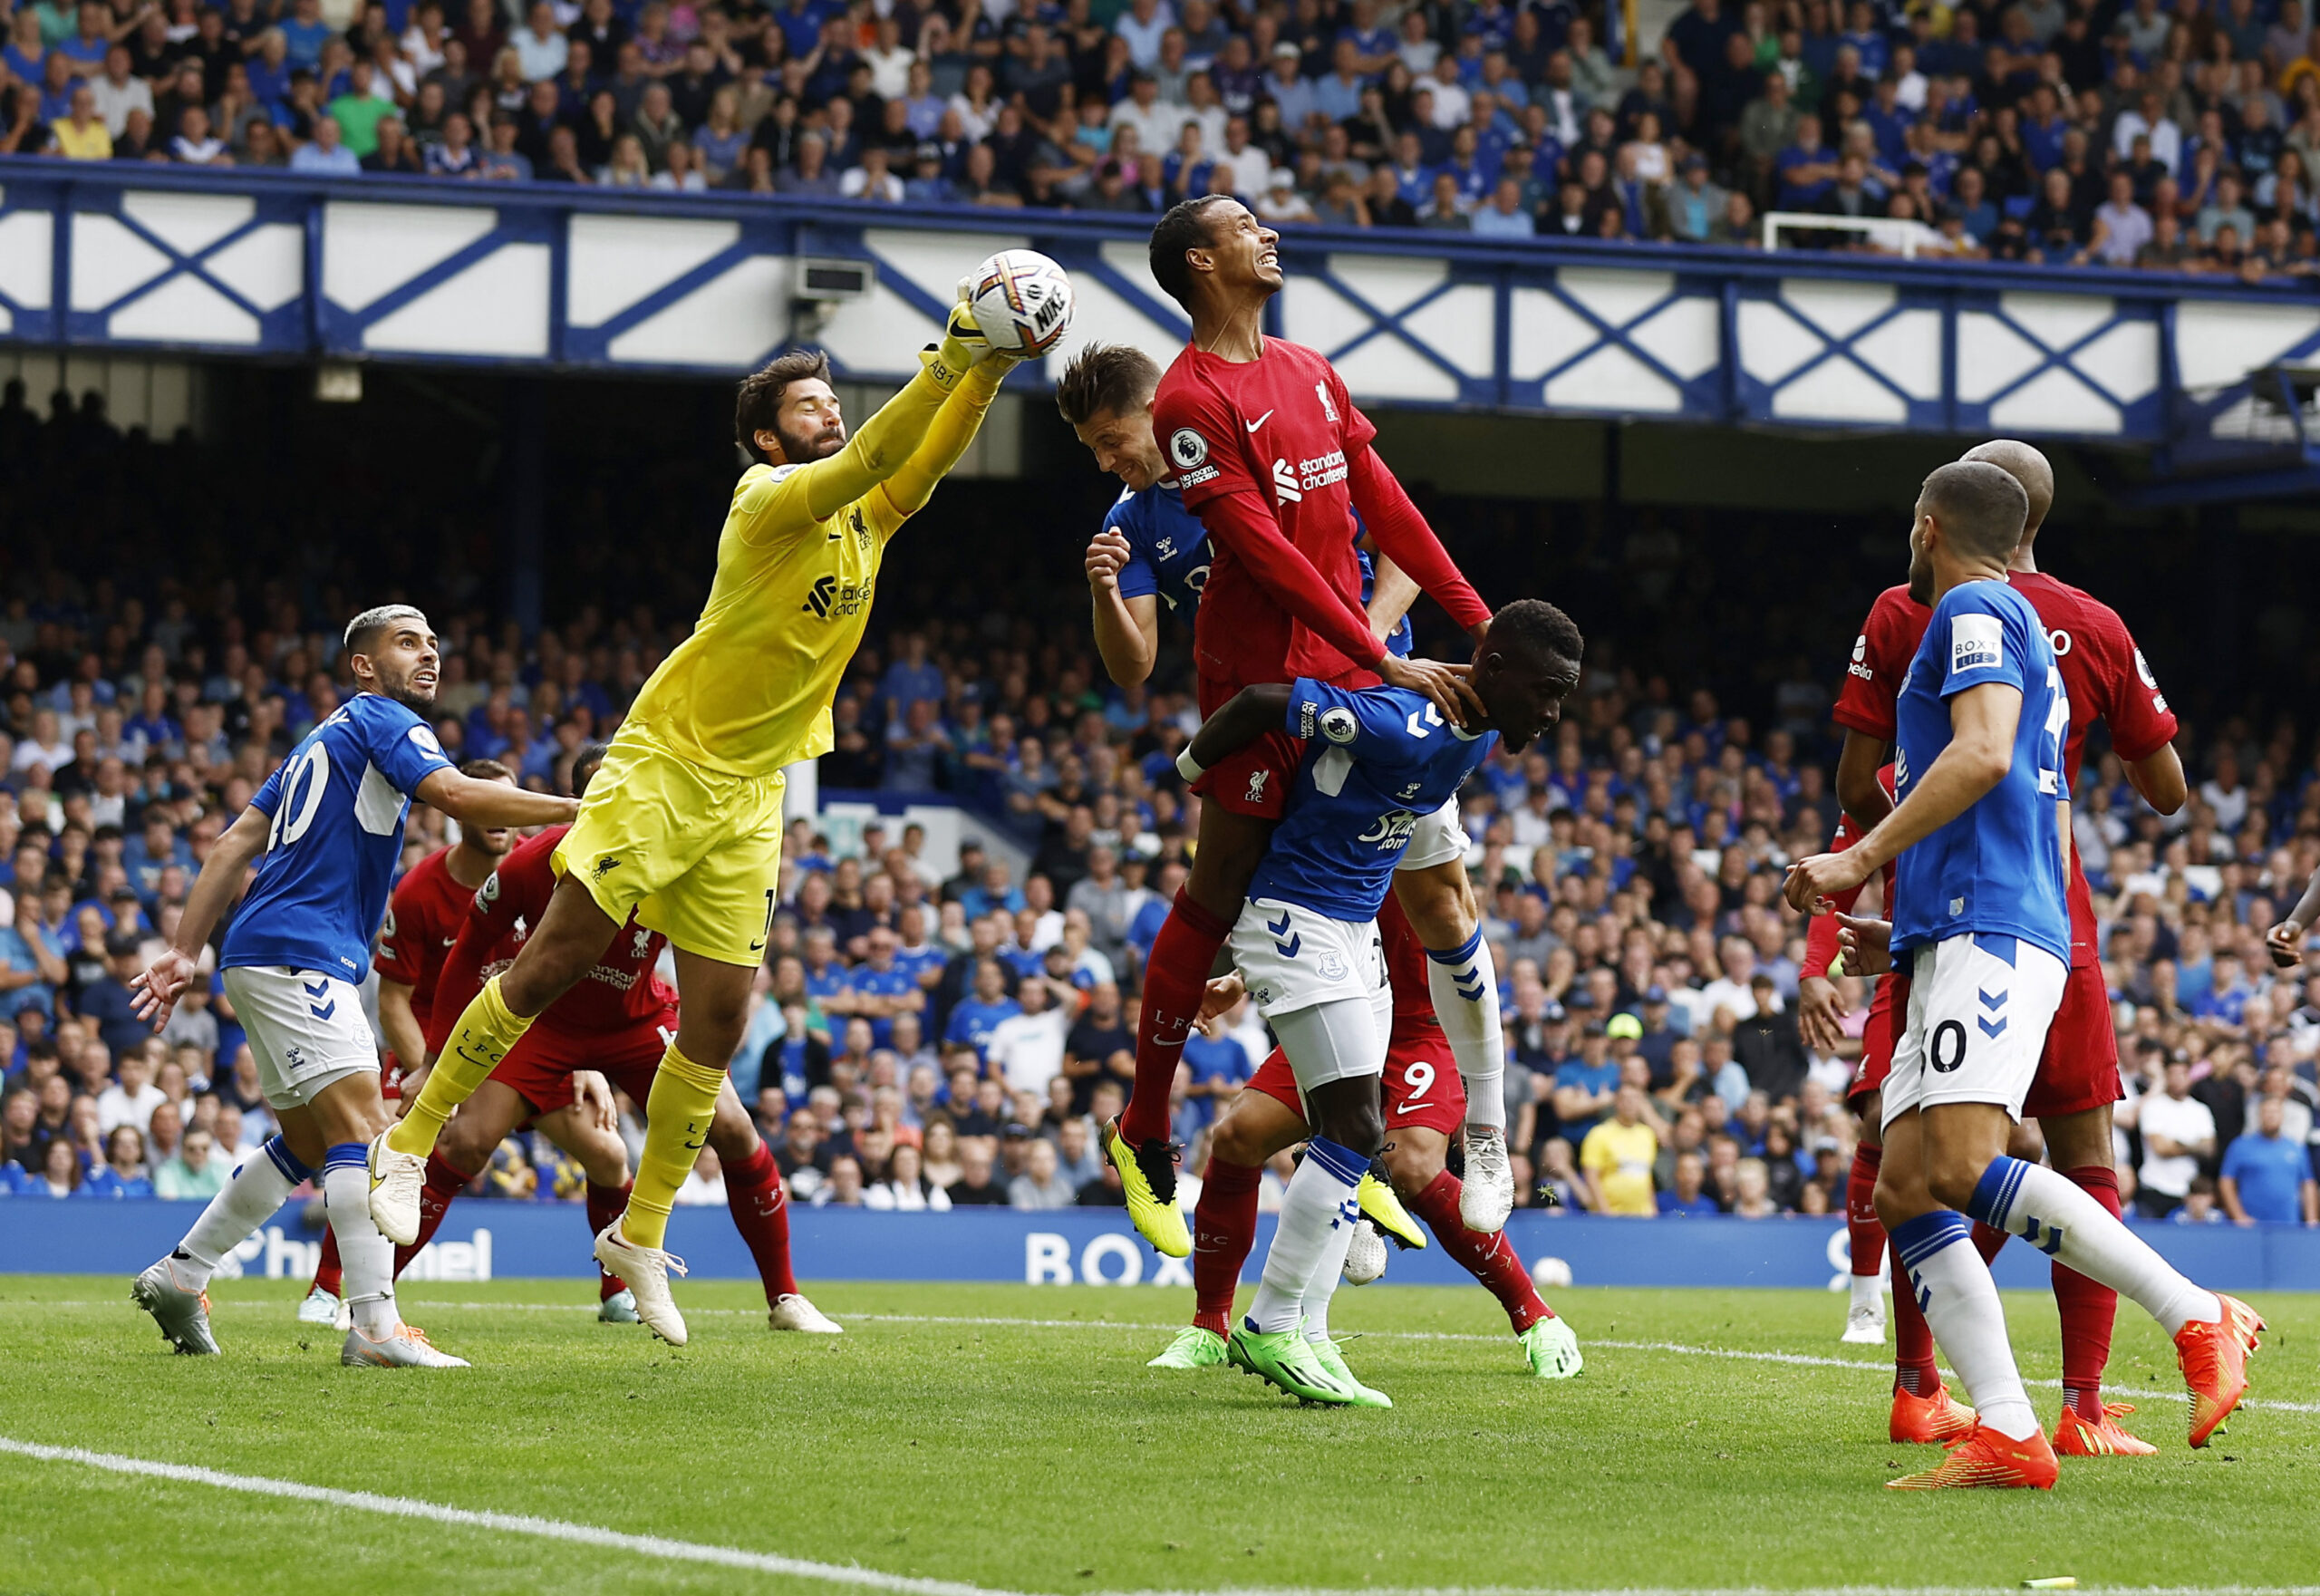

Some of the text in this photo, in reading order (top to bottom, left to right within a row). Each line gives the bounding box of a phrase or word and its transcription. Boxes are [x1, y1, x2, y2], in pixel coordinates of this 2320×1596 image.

[929, 360, 954, 385] AB1
[1179, 465, 1214, 482] No room
[1299, 449, 1346, 476] standard
[1193, 469, 1221, 485] racism
[1302, 463, 1348, 491] chartered
[1955, 639, 1999, 655] BOXT
[1961, 653, 1990, 666] LIFE
[1308, 701, 1318, 715] No
[1920, 1020, 1967, 1079] 0
[1404, 1061, 1436, 1099] 9
[1025, 1232, 1256, 1287] BOX
